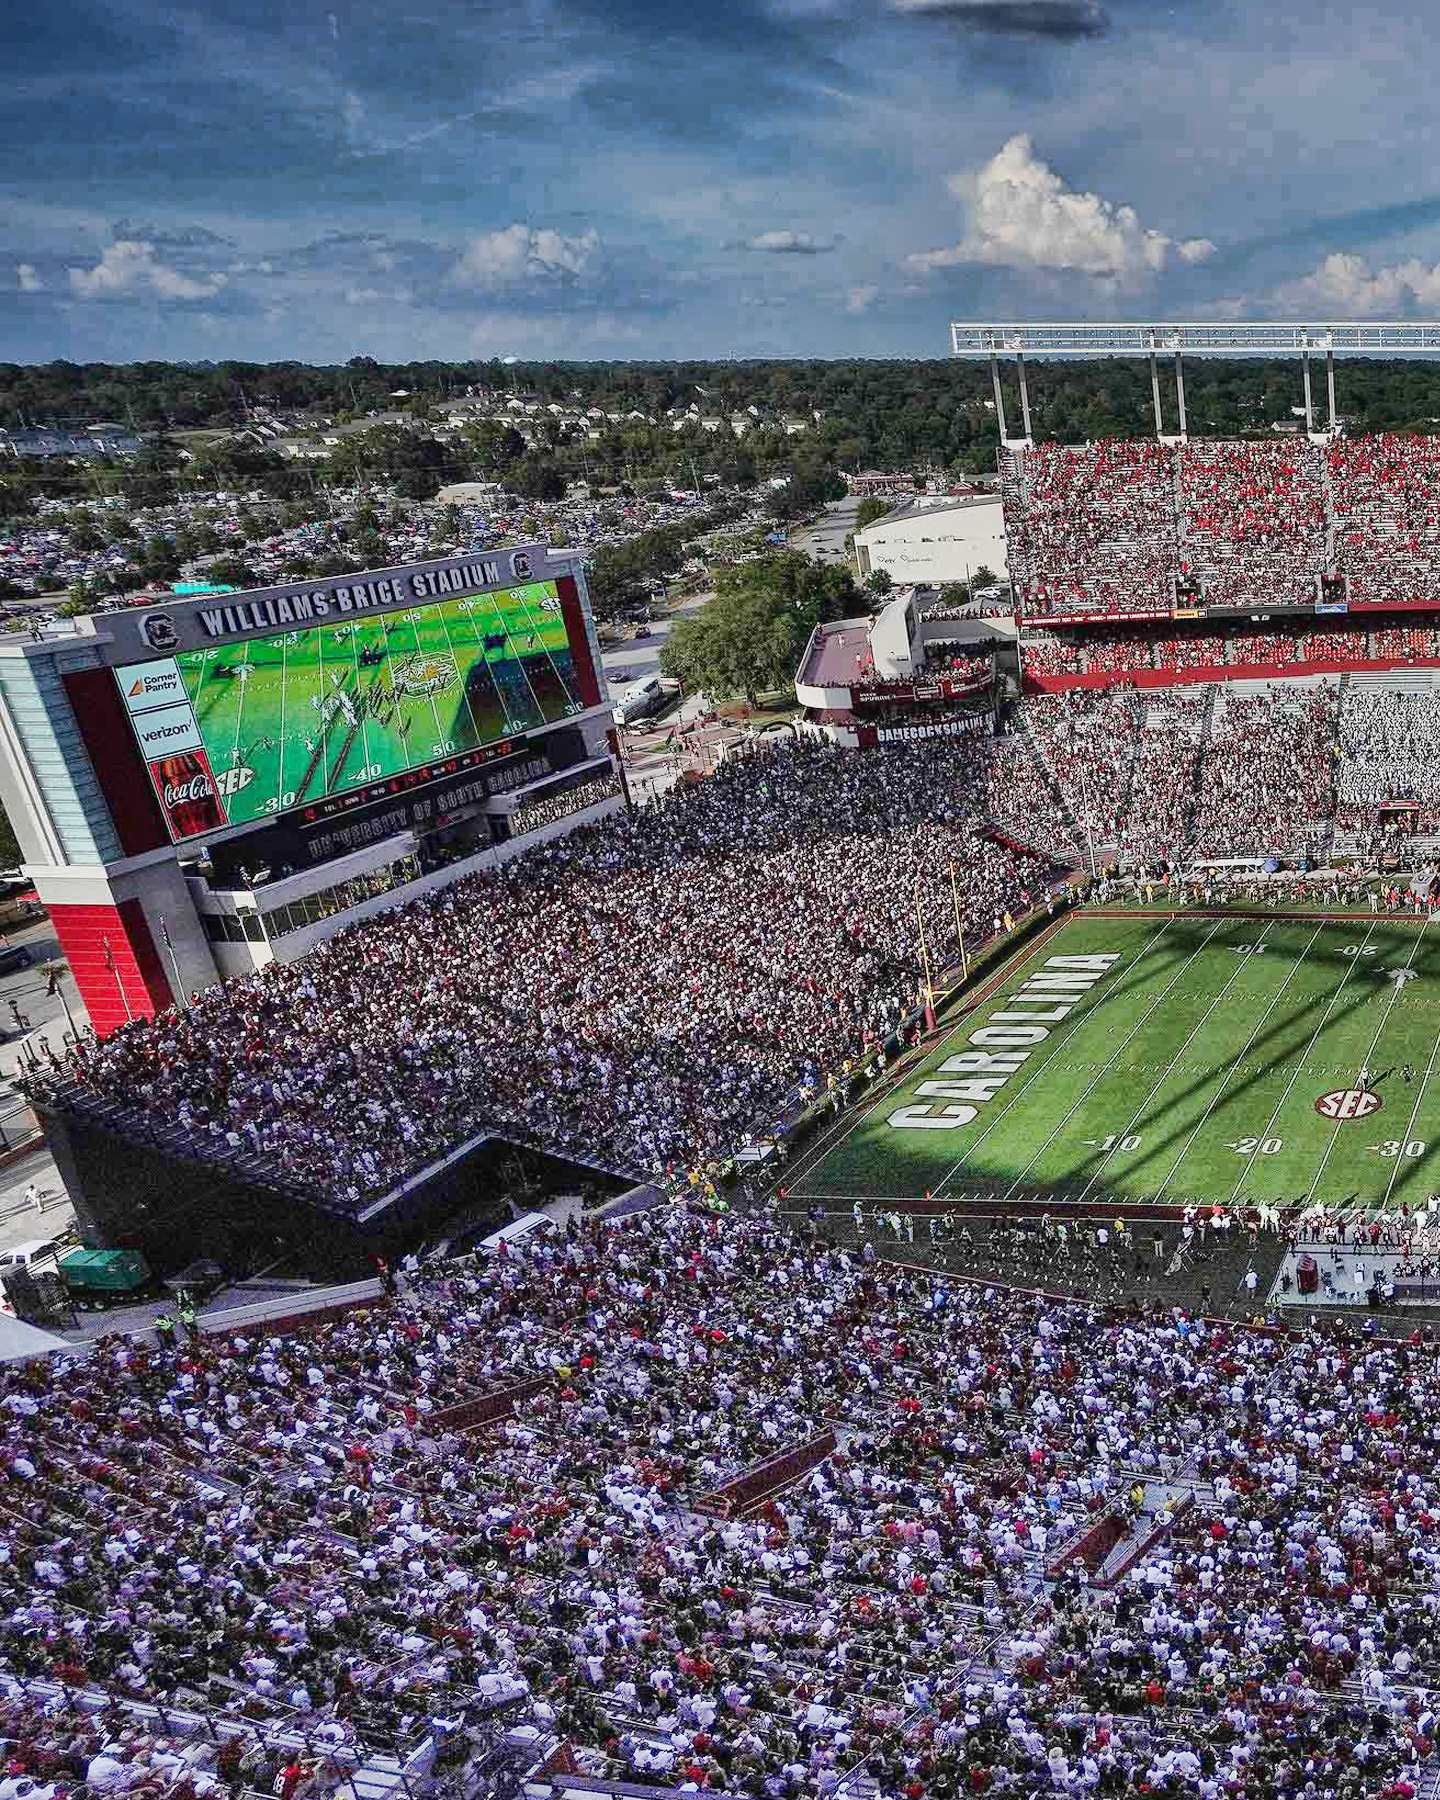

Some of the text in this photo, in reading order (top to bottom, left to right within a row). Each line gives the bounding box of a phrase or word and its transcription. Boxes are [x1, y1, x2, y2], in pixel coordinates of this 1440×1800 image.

[201, 561, 499, 636] WILLIAMS-BRICE STADIUM
[144, 672, 177, 686] Corner
[145, 680, 178, 694] Pantry
[142, 723, 188, 743] verizon
[164, 774, 216, 809] Coca-Cola
[413, 800, 431, 821] OF
[437, 781, 484, 812] SOUTH
[489, 757, 556, 793] CAROLINA
[887, 952, 1123, 1129] CAROLINA
[1318, 1090, 1381, 1119] SEC
[1098, 1135, 1142, 1151] 10
[1235, 1138, 1283, 1155] 20
[1379, 1141, 1426, 1158] 30
